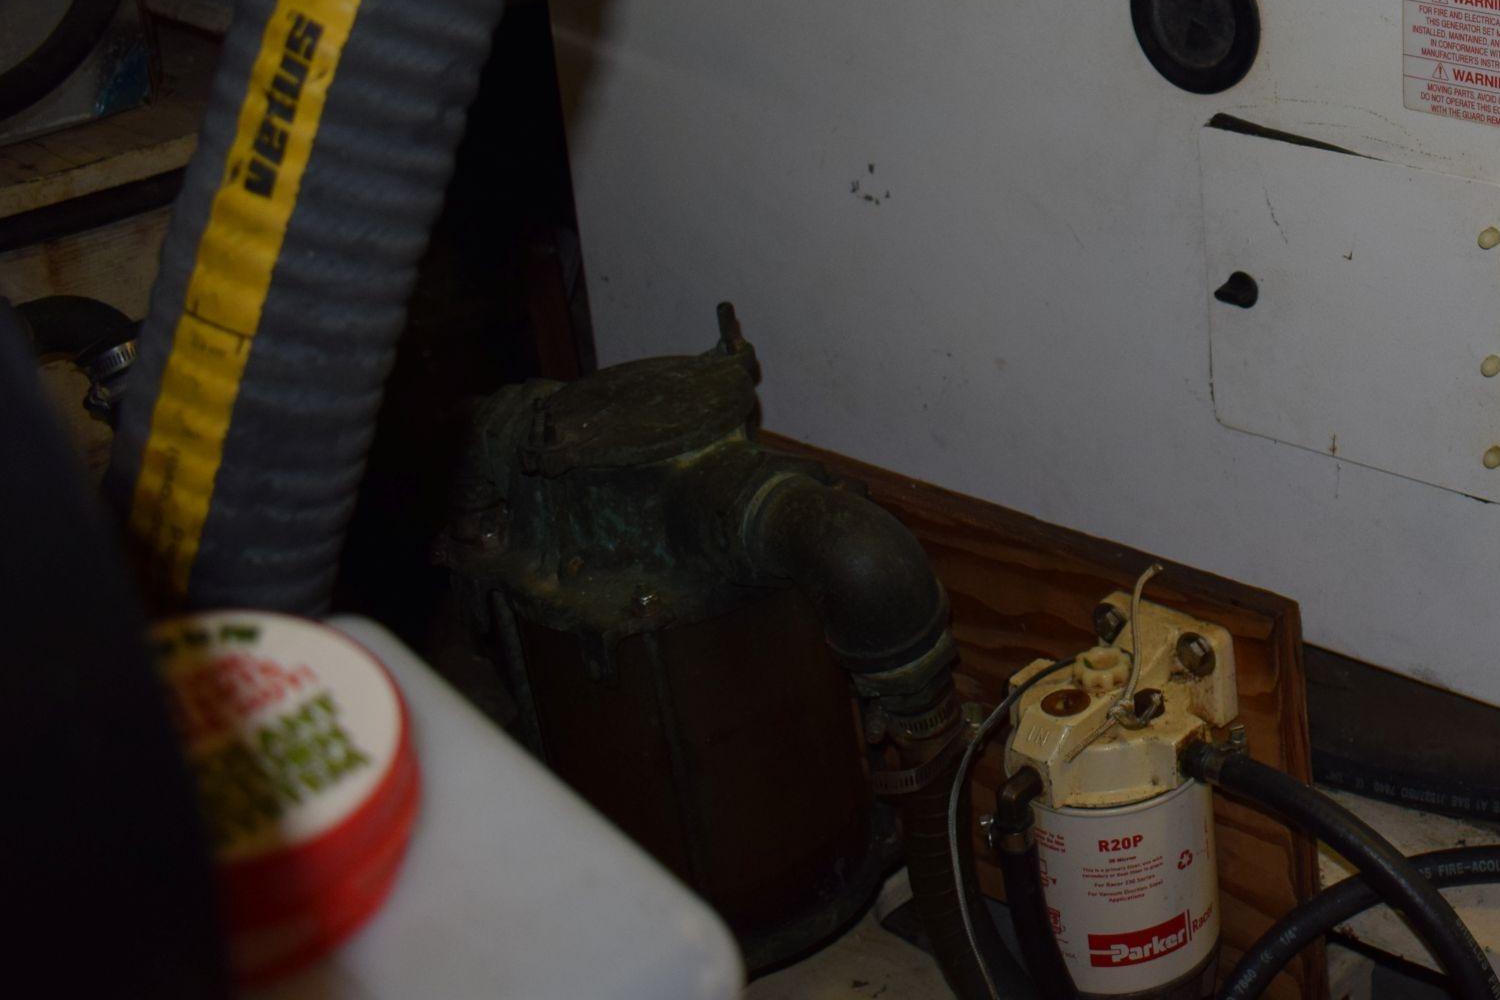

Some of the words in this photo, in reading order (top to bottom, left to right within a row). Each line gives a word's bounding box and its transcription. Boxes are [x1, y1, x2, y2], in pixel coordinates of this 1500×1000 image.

[1419, 5, 1432, 14] FOR
[1434, 8, 1448, 17] FIRE
[1449, 11, 1462, 19] AND
[1426, 17, 1440, 25] THIS
[1442, 20, 1481, 33] GENERATOR
[1483, 26, 1495, 36] SET
[1430, 39, 1438, 47] IN
[1439, 41, 1489, 56] CONFORMANCE
[1420, 92, 1430, 100] DO
[1432, 94, 1445, 102] NOT
[1446, 96, 1476, 110] OPERATE
[1477, 102, 1492, 112] THIS
[1427, 83, 1452, 95] MOVING
[1477, 92, 1498, 103] AVOID
[1431, 104, 1448, 115] WITH
[1449, 108, 1461, 117] THE
[1462, 110, 1486, 122] GUARD
[1098, 834, 1143, 852] R20P
[1438, 860, 1500, 875] FIRE-ACOL
[1110, 927, 1186, 963] Parker
